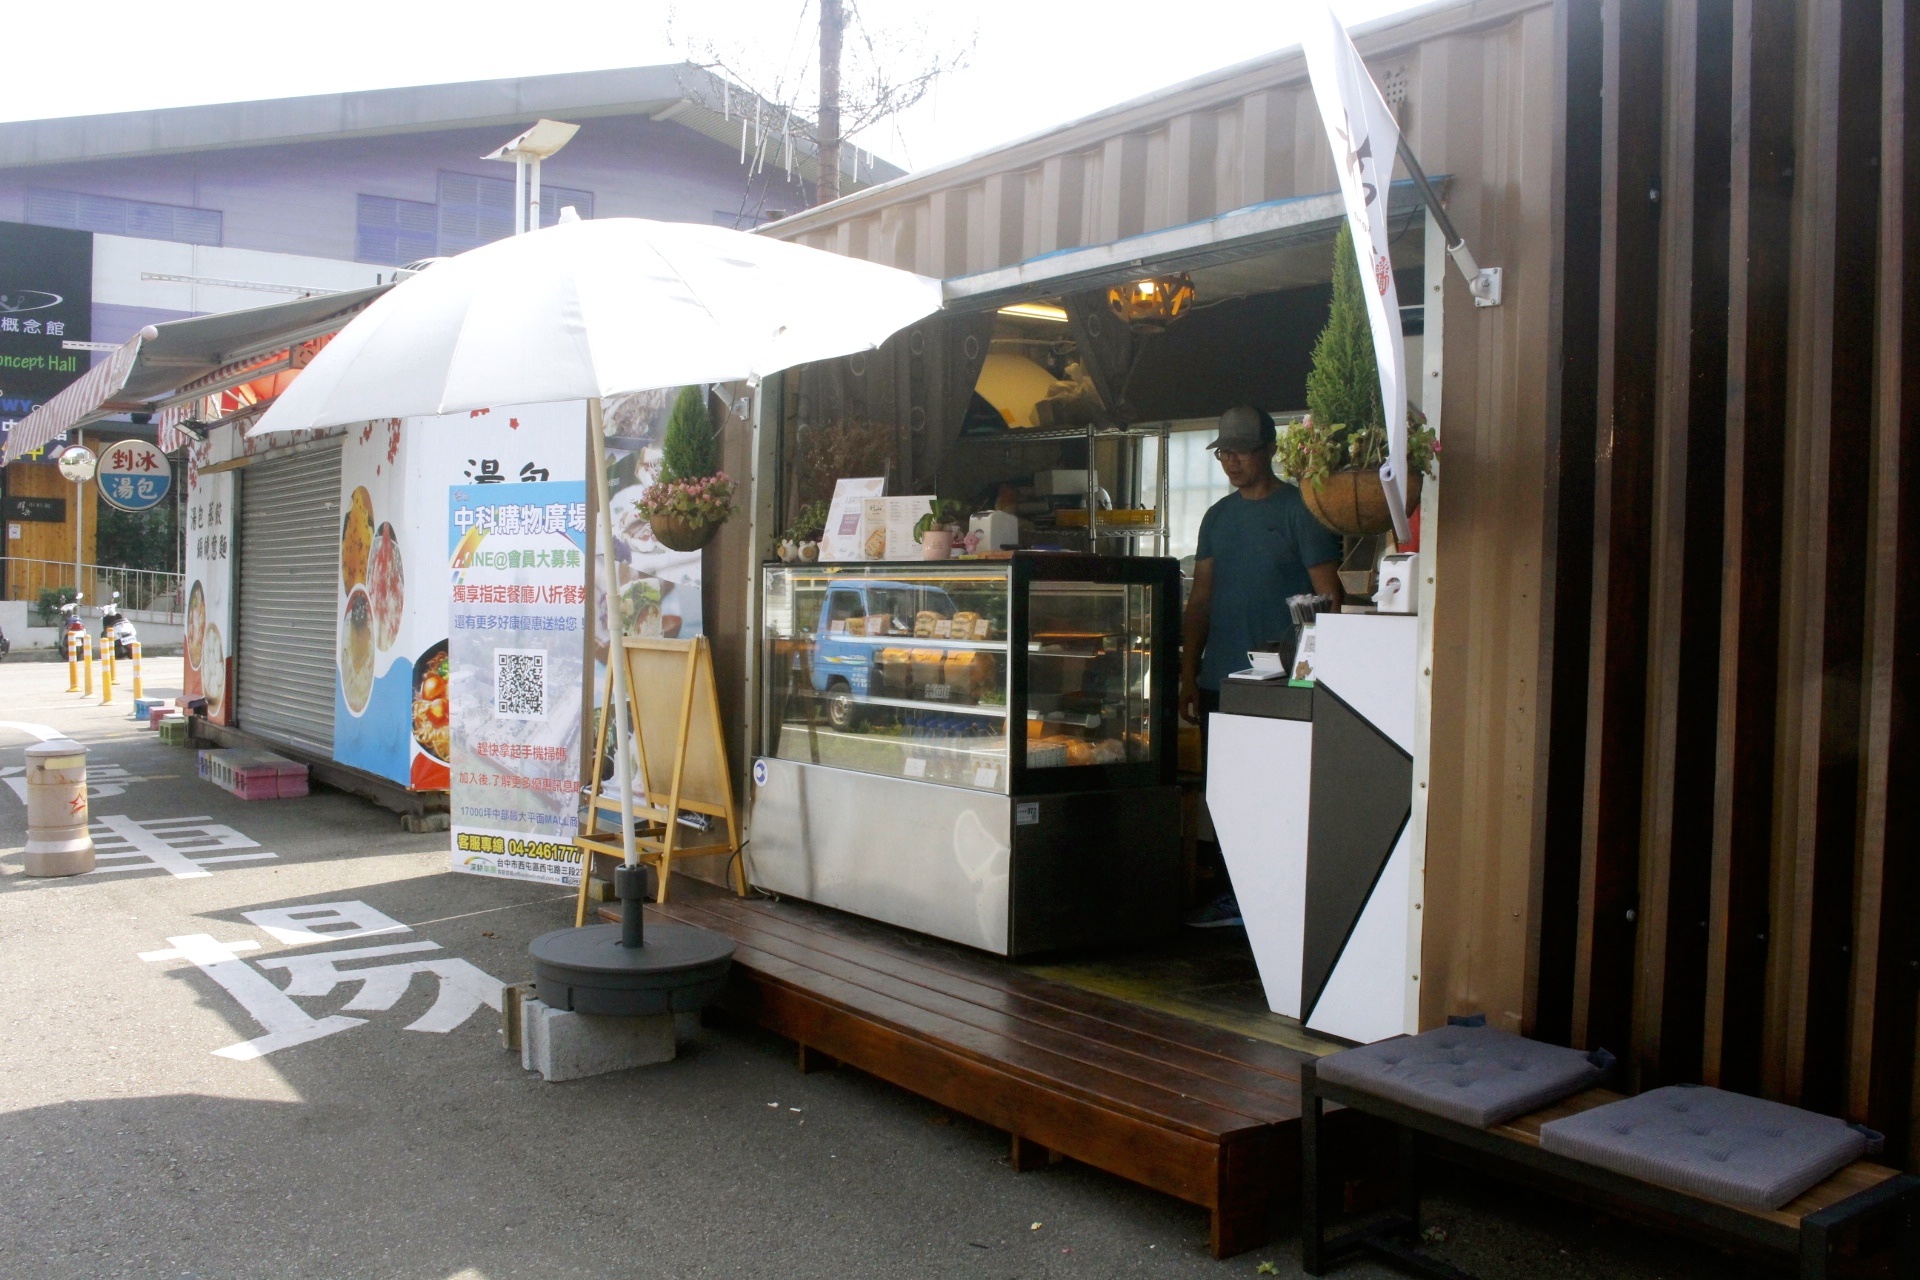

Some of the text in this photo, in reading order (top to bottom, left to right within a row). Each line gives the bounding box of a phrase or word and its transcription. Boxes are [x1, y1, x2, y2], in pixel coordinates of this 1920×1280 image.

[1, 316, 65, 336] 概念館
[48, 355, 76, 372] Hall
[112, 477, 157, 500] 湯包
[454, 502, 586, 536] 中科購物廣場
[457, 833, 505, 855] 客服專線
